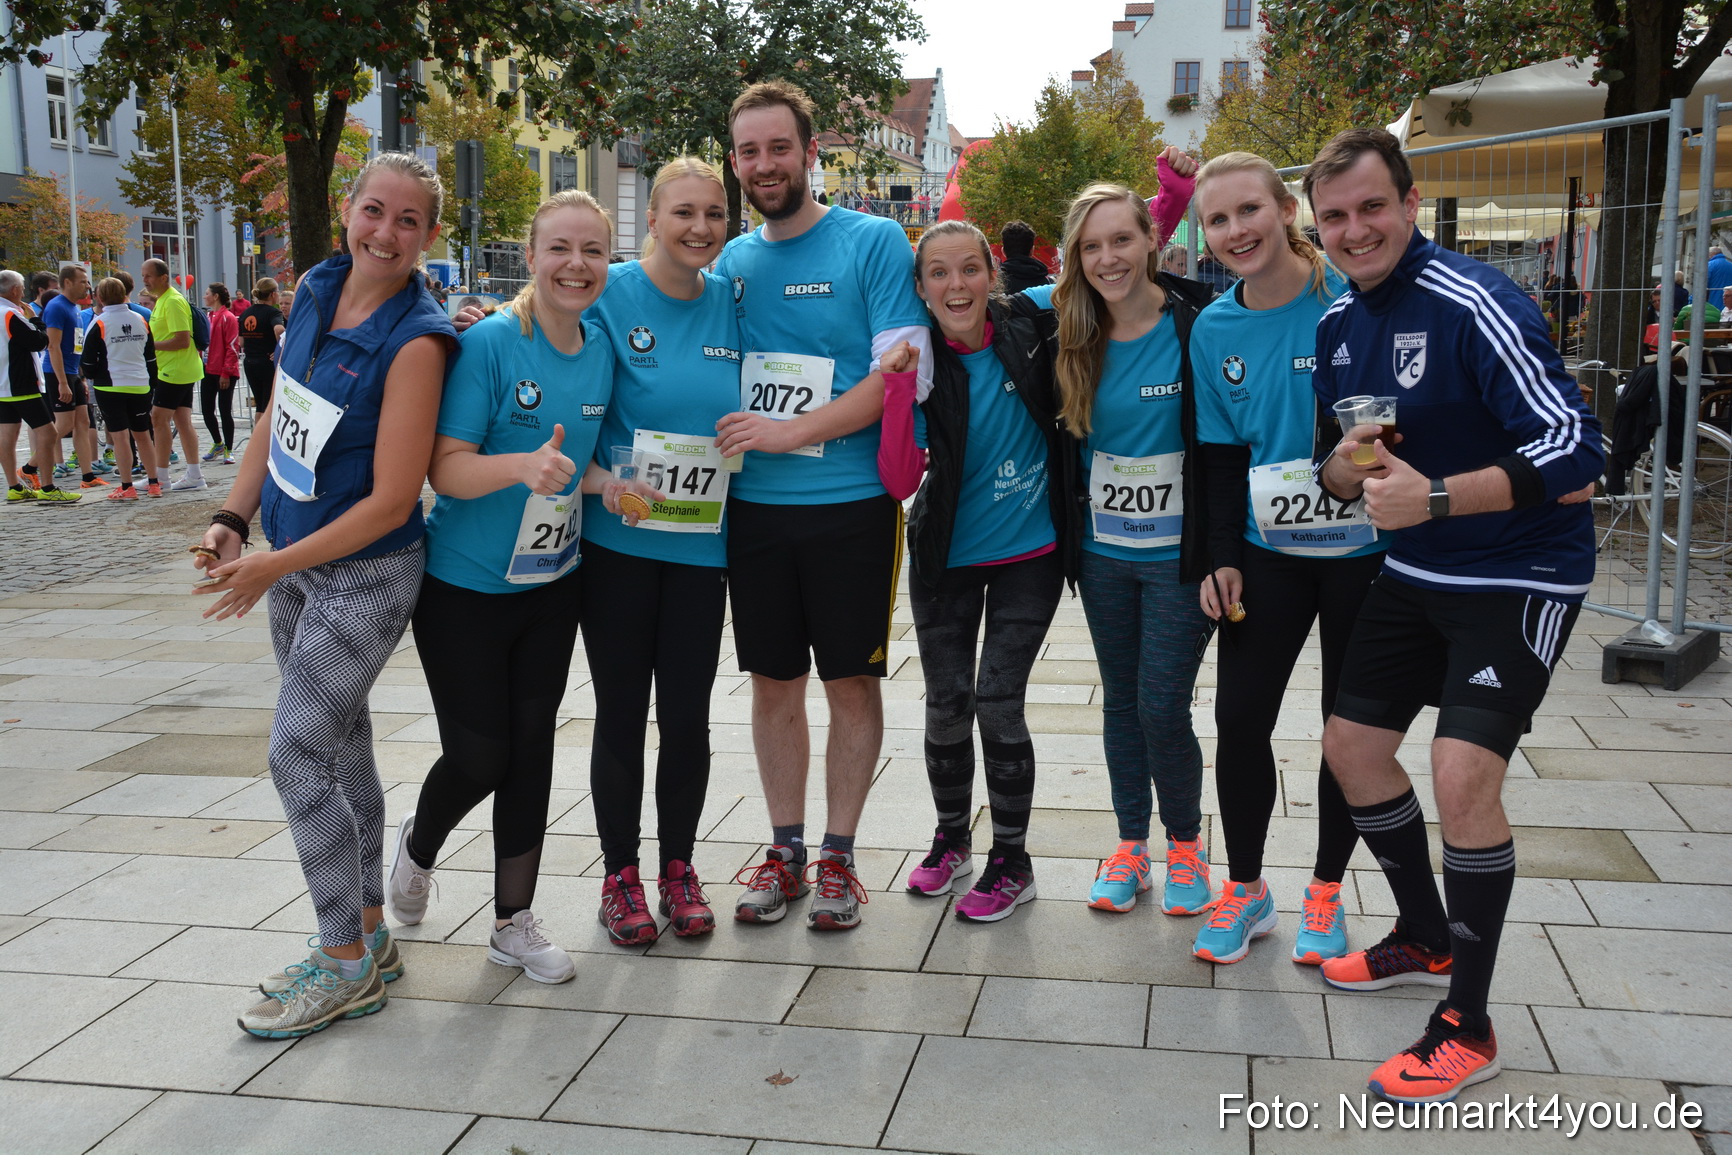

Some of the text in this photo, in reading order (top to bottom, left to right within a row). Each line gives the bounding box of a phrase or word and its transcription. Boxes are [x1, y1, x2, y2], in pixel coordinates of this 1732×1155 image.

[245, 224, 251, 239] P
[784, 282, 833, 296] BOCK
[702, 345, 740, 361] BOCK
[1400, 349, 1410, 368] F
[629, 356, 658, 364] PARTL
[1293, 355, 1316, 370] BO
[1332, 357, 1351, 366] adidas
[771, 362, 802, 373] BOCK
[1410, 362, 1419, 379] C
[749, 382, 814, 415] 2072
[1229, 387, 1249, 399] PARTL
[288, 389, 312, 411] BOCK
[511, 411, 540, 424] PARTL
[509, 419, 540, 430] Neumarkt
[675, 443, 706, 454] BOCK
[1121, 464, 1157, 474] BOCK
[1294, 469, 1312, 479] BO
[646, 462, 717, 495] 5147
[1103, 483, 1173, 513] 2207
[652, 502, 701, 516] Stephanie
[1271, 490, 1357, 526] 2242
[530, 509, 577, 550] 2142
[1123, 520, 1155, 533] Carina
[1291, 530, 1346, 543] Katharina
[1531, 564, 1556, 572] climacool
[1469, 676, 1502, 688] adidas
